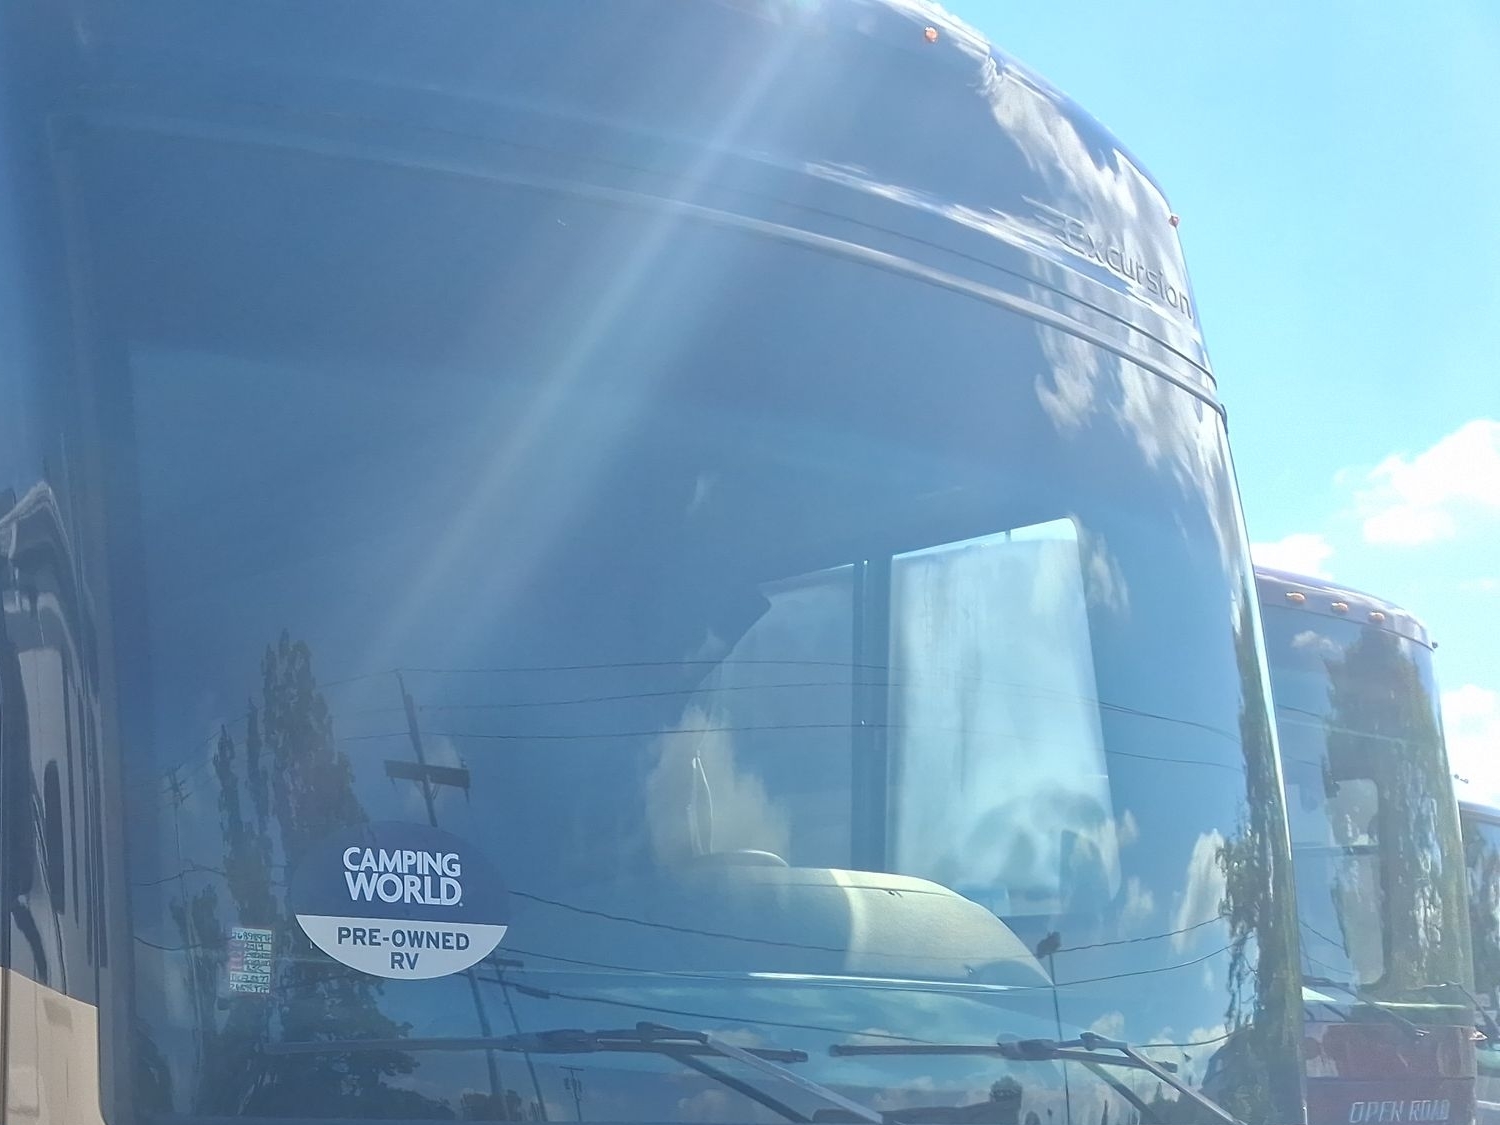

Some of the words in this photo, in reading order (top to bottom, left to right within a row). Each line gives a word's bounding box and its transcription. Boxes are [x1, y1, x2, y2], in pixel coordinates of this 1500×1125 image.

[1022, 194, 1193, 320] Excursion
[342, 847, 461, 877] CAMPING
[344, 871, 464, 907] WORLD
[337, 926, 470, 951] PRE-OWNED
[390, 951, 420, 970] RV
[1349, 1100, 1404, 1124] OPEN
